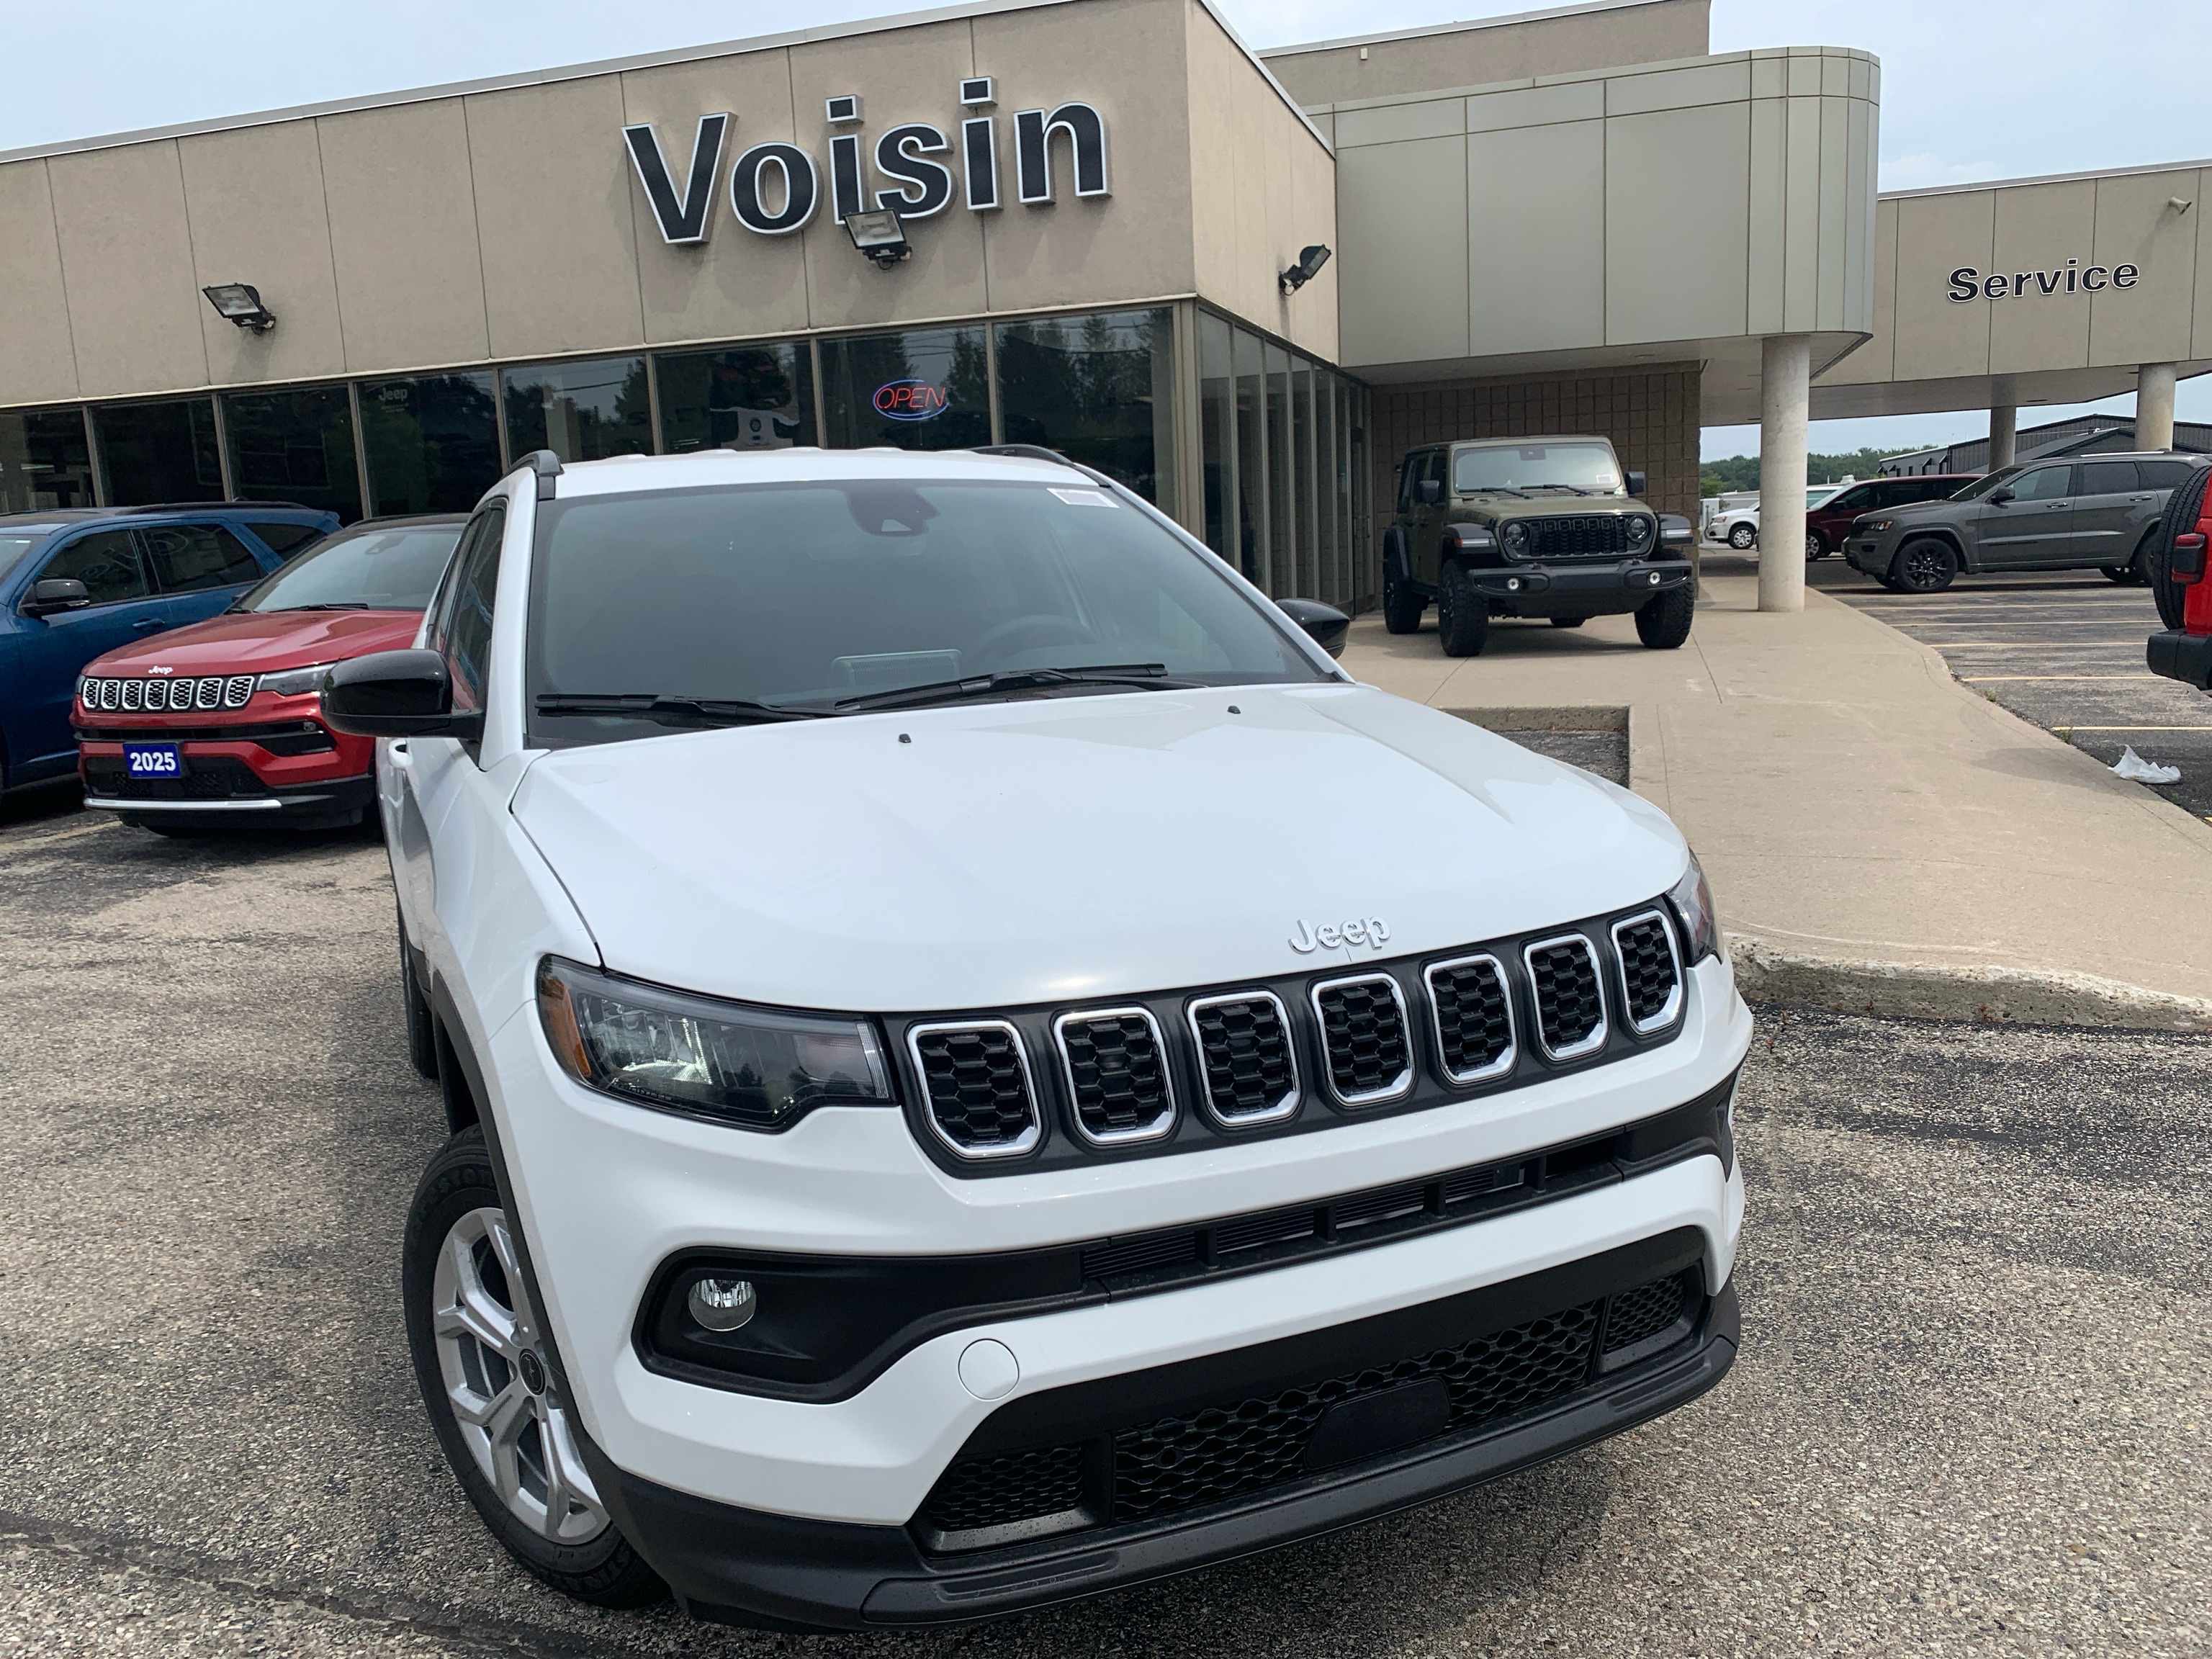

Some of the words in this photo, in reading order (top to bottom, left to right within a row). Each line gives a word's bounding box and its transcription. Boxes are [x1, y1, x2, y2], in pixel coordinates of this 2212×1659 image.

[621, 76, 1112, 245] Voisin
[1947, 257, 2140, 302] Service
[378, 387, 408, 401] Jeep
[876, 387, 946, 409] OPEN
[148, 665, 174, 675] Jeep
[130, 752, 176, 772] 2025
[1287, 915, 1391, 956] Jeep
